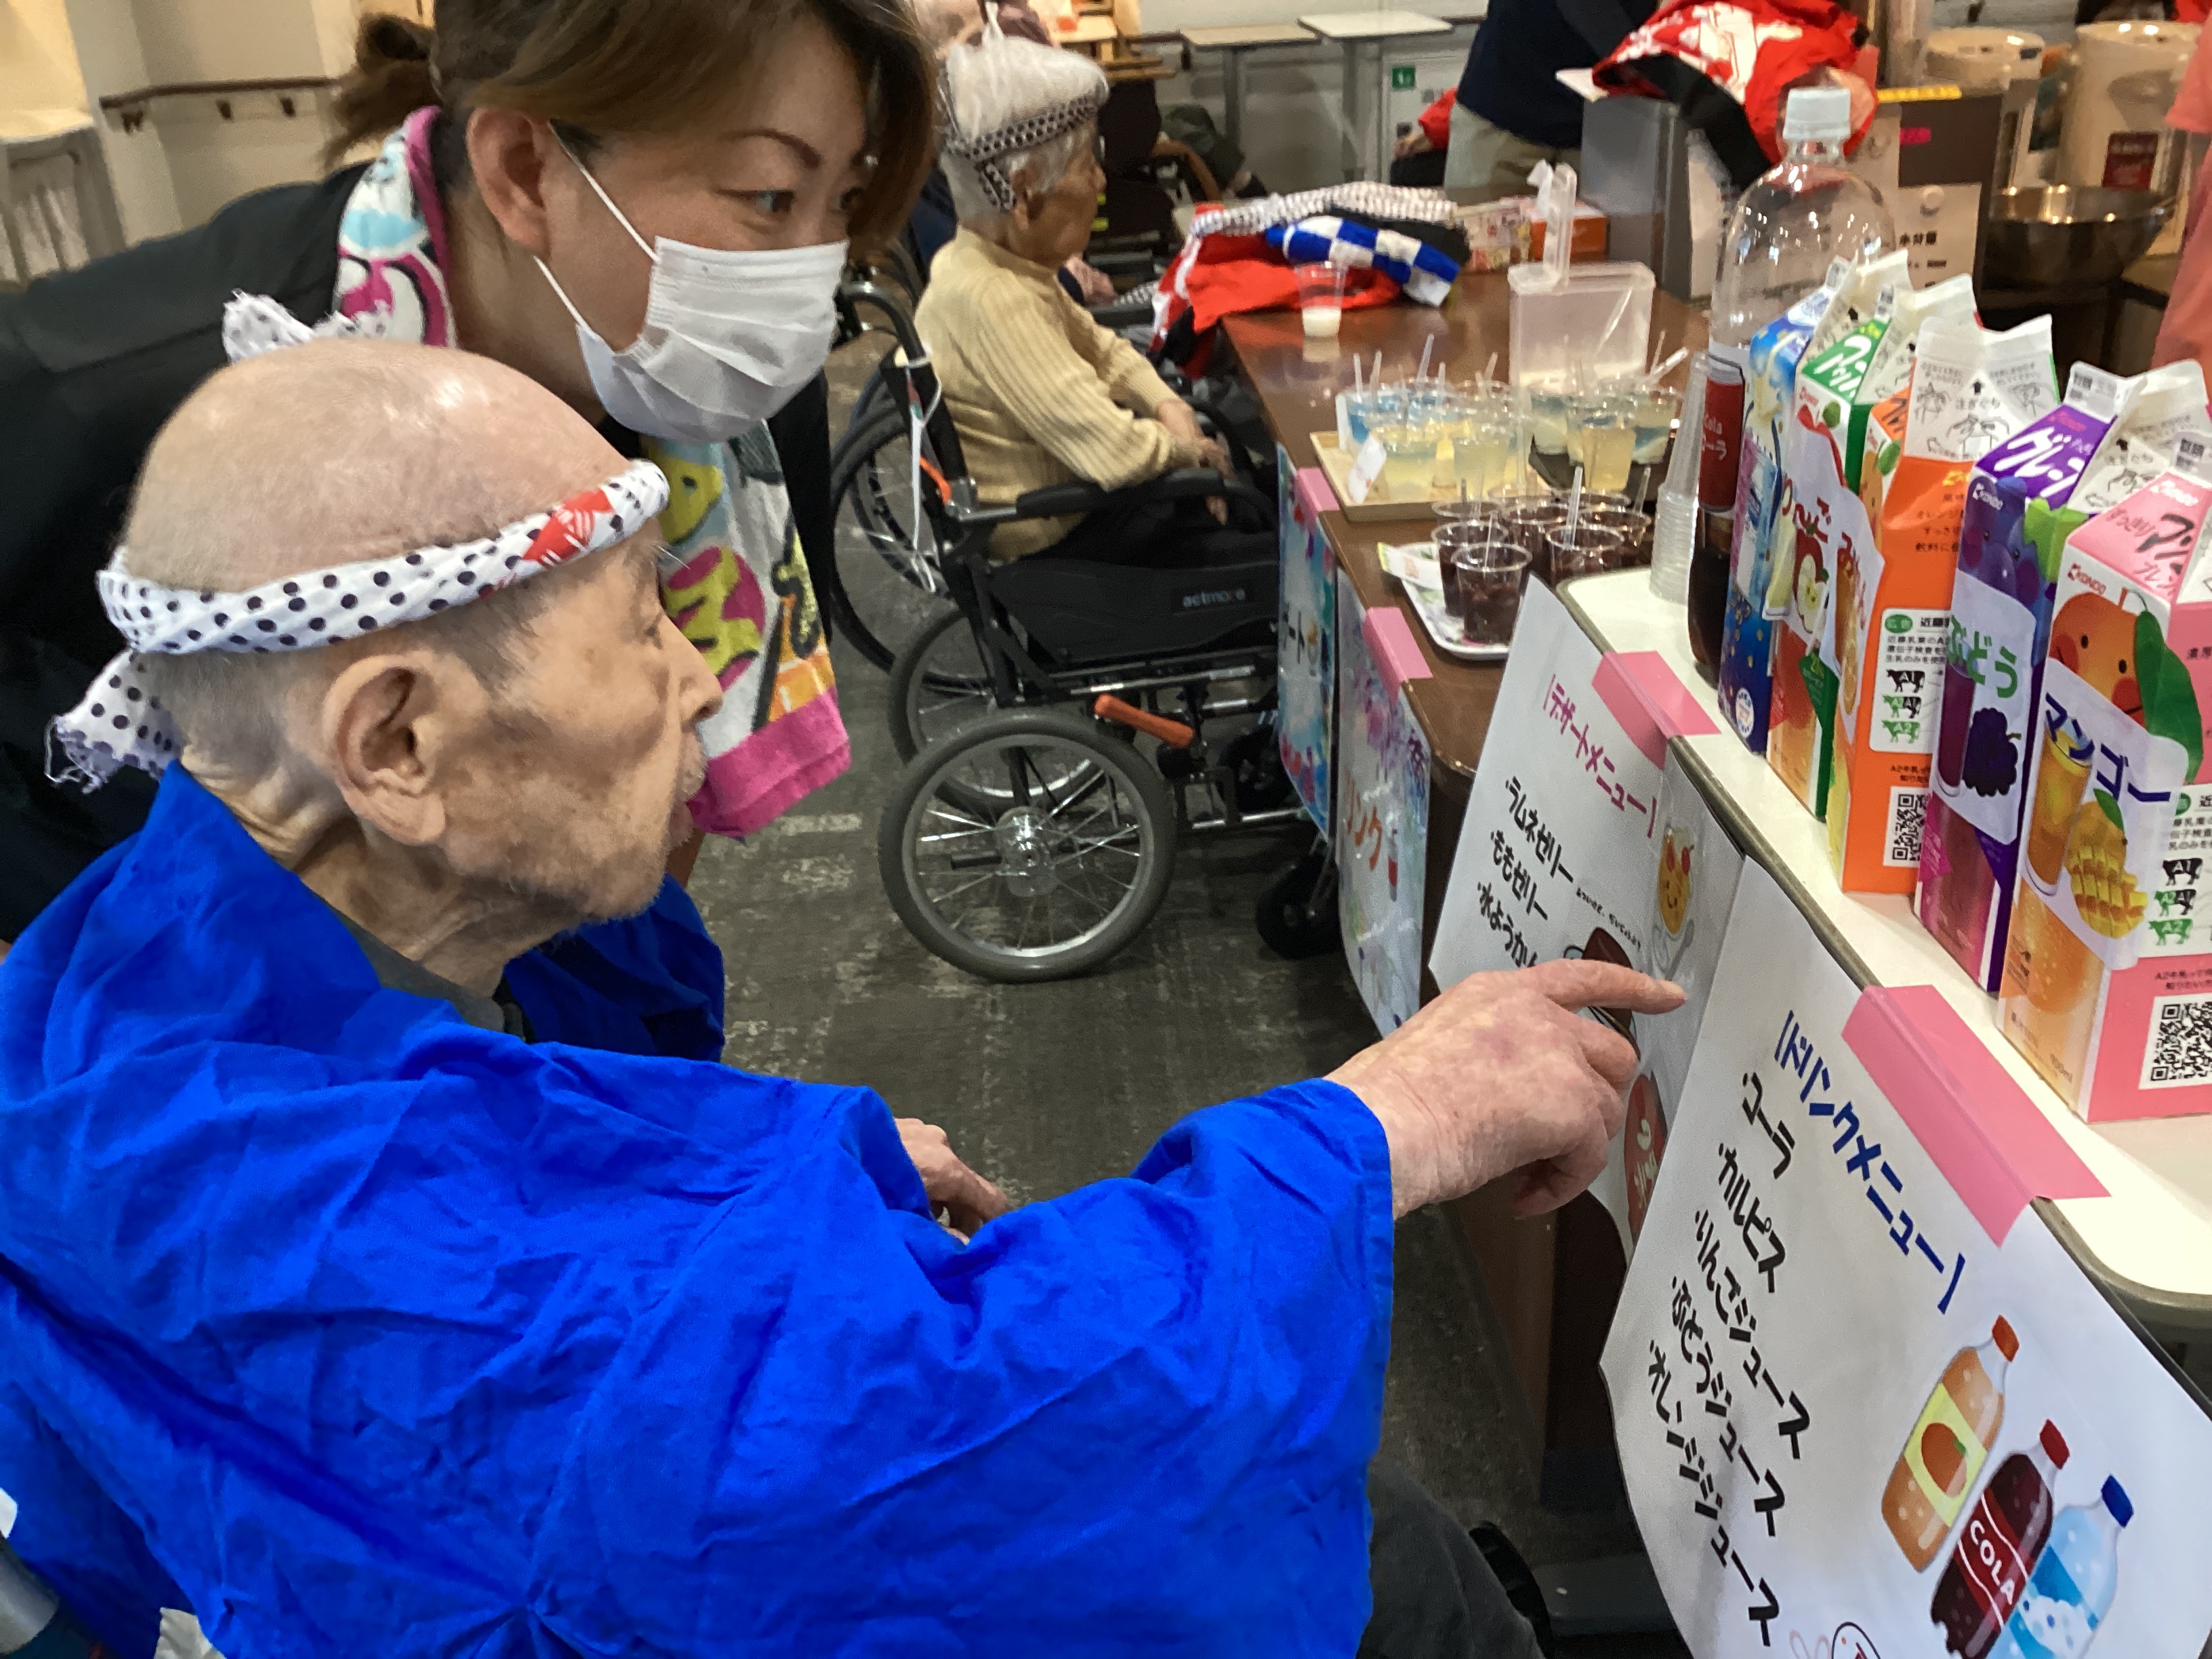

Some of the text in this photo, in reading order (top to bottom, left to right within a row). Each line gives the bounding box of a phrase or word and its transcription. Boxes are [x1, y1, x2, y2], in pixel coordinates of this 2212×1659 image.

[1947, 614, 2018, 699] ぶどう
[2045, 692, 2171, 802] マンゴー
[1969, 1519, 2017, 1606] COLA
